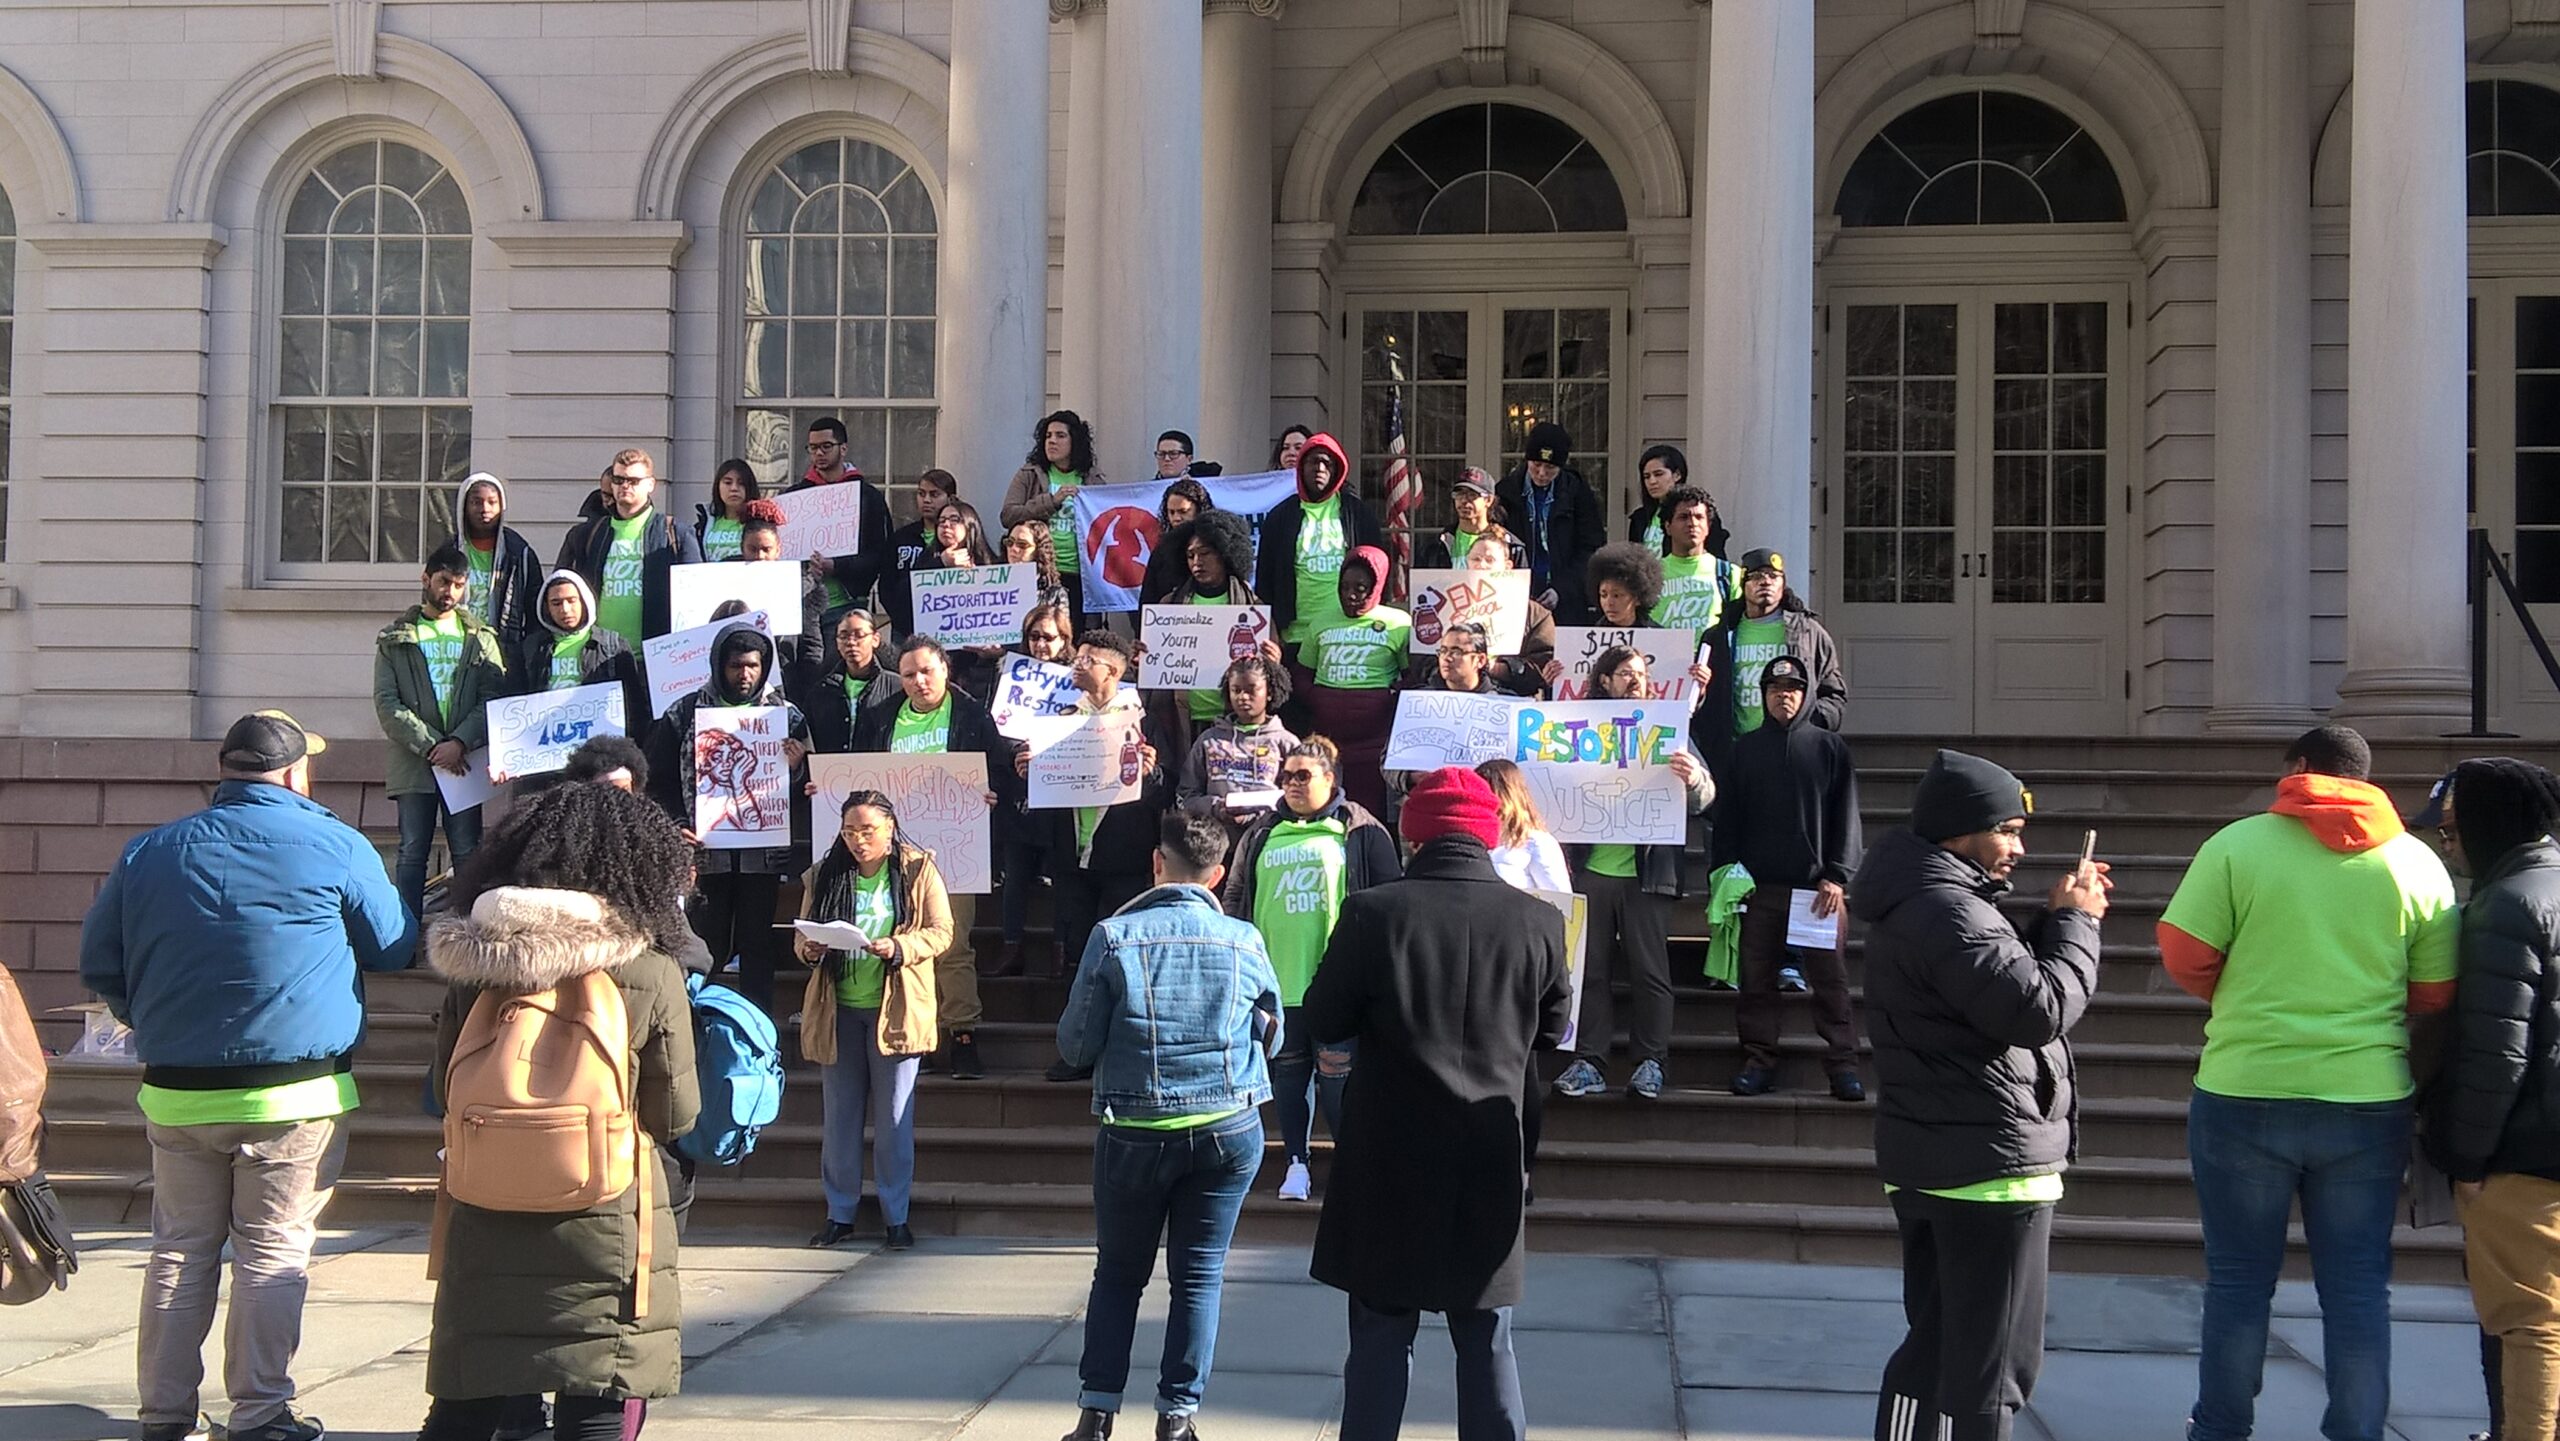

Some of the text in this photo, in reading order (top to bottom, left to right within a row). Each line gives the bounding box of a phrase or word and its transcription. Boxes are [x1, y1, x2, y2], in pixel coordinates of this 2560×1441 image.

[914, 566, 1012, 587] INVEST IN
[605, 580, 643, 598] COPS
[921, 588, 1020, 614] RESTORATIVE
[939, 612, 1012, 631] JUSTICE
[1144, 607, 1214, 626] Decriminalize
[1161, 632, 1198, 648] YOUTH
[1581, 630, 1635, 657] $431
[1164, 652, 1197, 668] Color
[1321, 643, 1377, 669] NOT
[1159, 667, 1198, 686] Now!
[500, 688, 622, 744] Support
[752, 717, 770, 735] ARE
[1515, 708, 1677, 770] RESTORATIVE
[751, 741, 780, 757] TIRED
[763, 761, 776, 776] OF
[1529, 767, 1676, 842] JUSTICE
[1285, 889, 1329, 914] COPS
